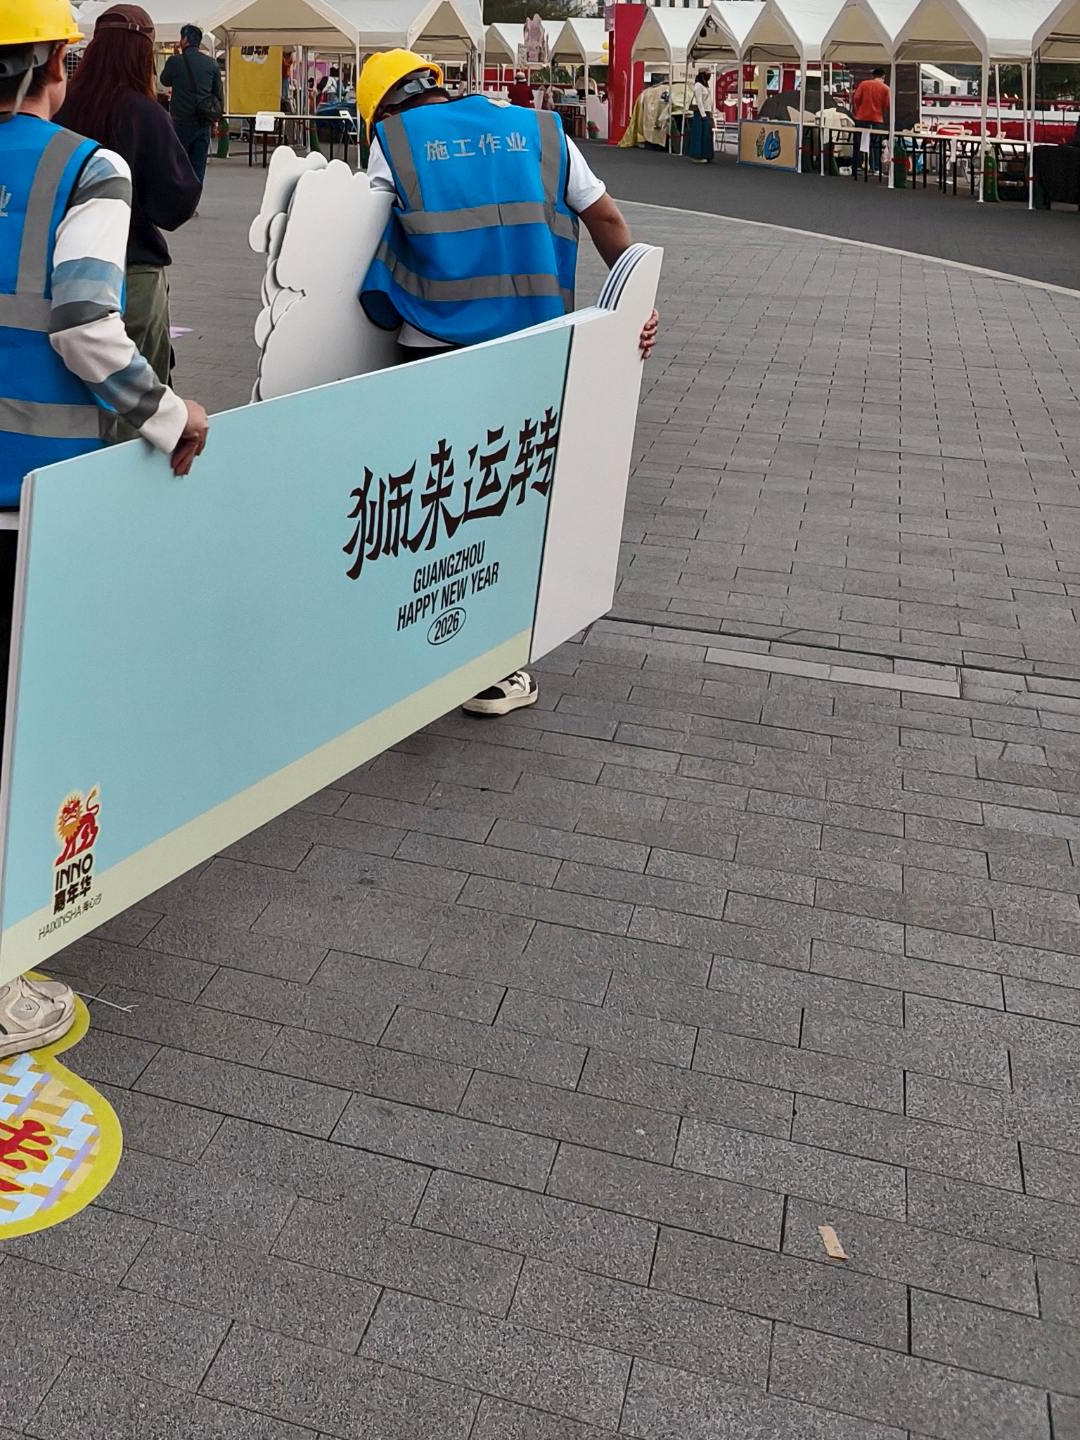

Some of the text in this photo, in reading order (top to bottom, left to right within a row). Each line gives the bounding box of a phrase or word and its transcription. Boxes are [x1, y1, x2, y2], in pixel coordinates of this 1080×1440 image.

[425, 131, 530, 160] 施工作业
[342, 405, 560, 580] 狮来运转
[413, 540, 485, 593] GUANGZHOU
[397, 562, 499, 631] HAPPY NEW YEAR
[434, 611, 460, 641] 2026
[55, 853, 93, 891] INNO
[53, 875, 92, 915] 嘉年华
